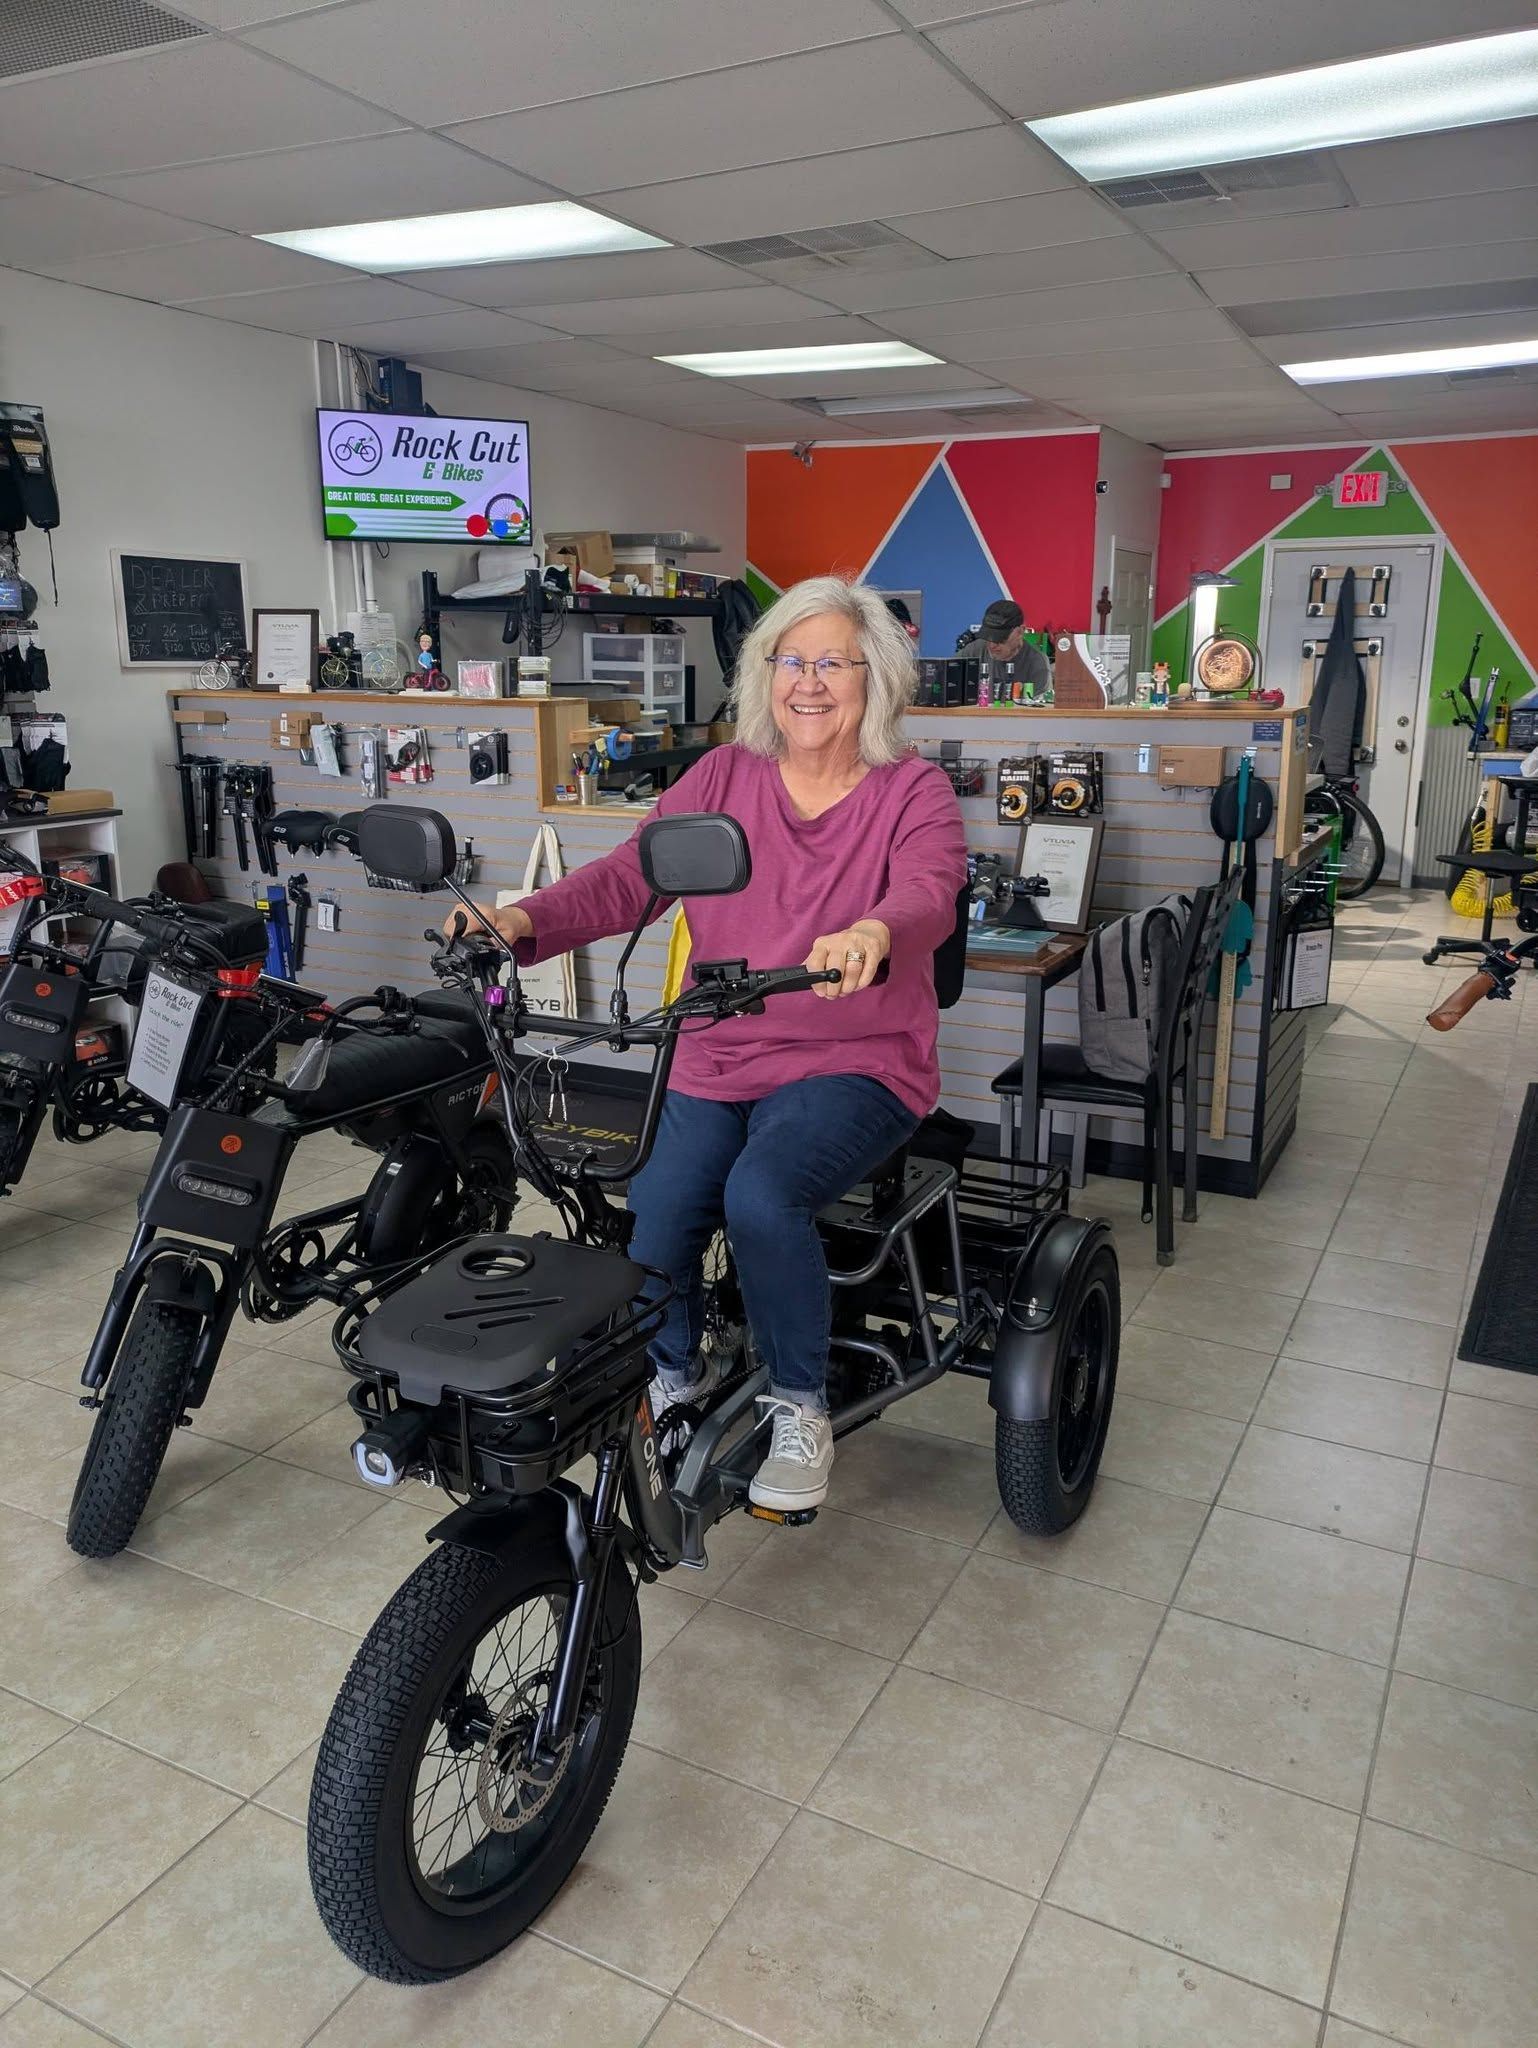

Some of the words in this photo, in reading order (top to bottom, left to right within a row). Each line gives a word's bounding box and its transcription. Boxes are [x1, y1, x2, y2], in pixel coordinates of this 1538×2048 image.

[392, 427, 463, 461] Rock
[469, 431, 521, 464] Cut
[442, 463, 484, 482] Bikes
[328, 491, 352, 501] GREAT
[354, 493, 378, 503] RIDES,
[380, 494, 404, 504] GREAT
[405, 495, 452, 506] EXPERIENCE!
[1341, 472, 1382, 502] EXIT
[1091, 656, 1111, 686] 2023
[161, 986, 178, 1002] Rock
[179, 996, 194, 1011] Cut
[521, 998, 561, 1012] EYB
[643, 1437, 663, 1501] ONE
